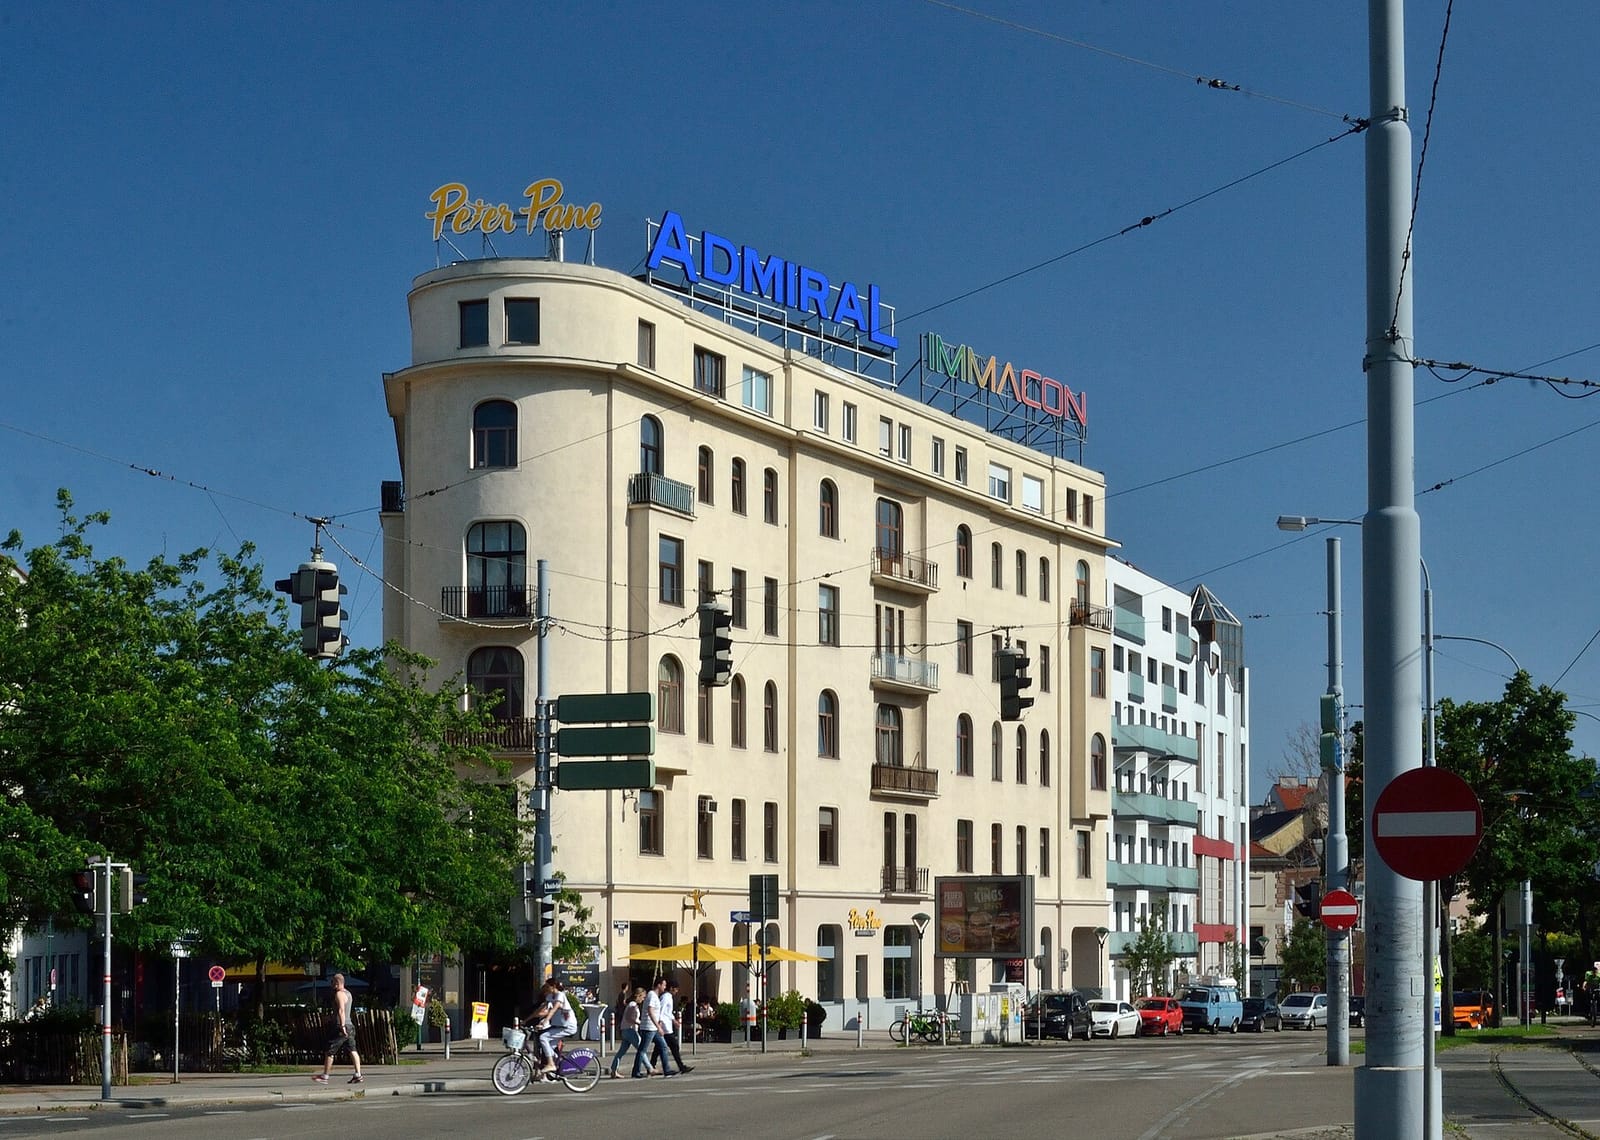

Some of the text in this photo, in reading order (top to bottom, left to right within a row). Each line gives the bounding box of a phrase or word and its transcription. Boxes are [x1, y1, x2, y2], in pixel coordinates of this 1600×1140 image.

[425, 178, 602, 241] Peter Pane
[645, 210, 899, 349] ADMIRAL
[927, 331, 1087, 427] IMMACON
